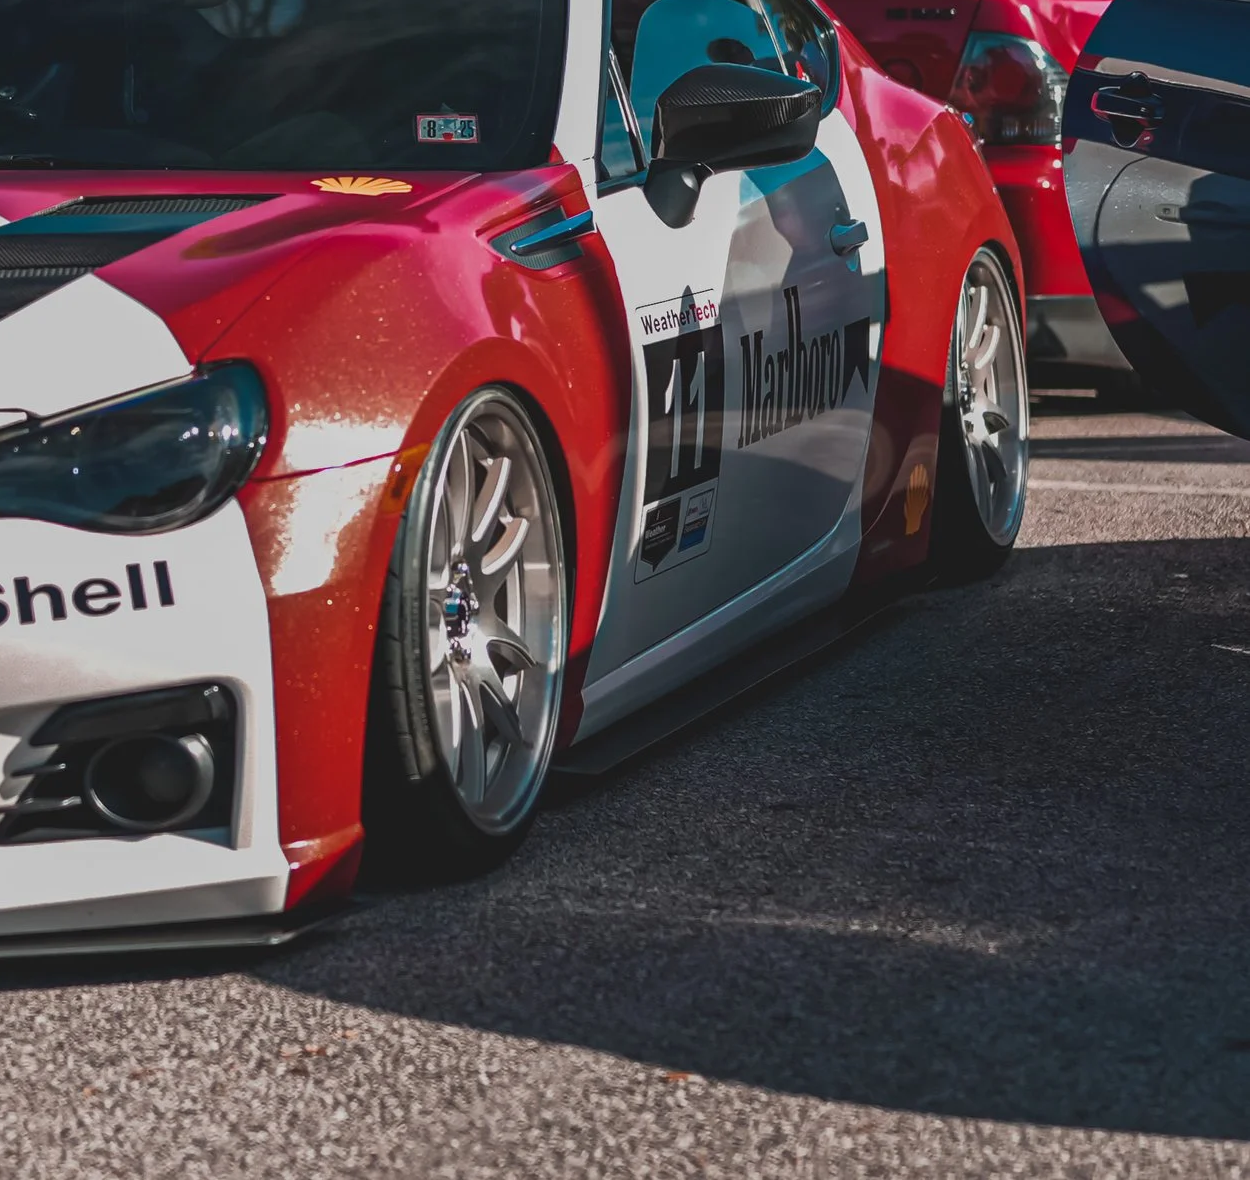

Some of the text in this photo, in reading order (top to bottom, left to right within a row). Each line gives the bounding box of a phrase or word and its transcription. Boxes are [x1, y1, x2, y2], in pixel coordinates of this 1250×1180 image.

[427, 119, 475, 139] 8 25
[640, 299, 717, 335] WeatherTech
[737, 285, 841, 449] Marlboro
[664, 350, 706, 479] 11
